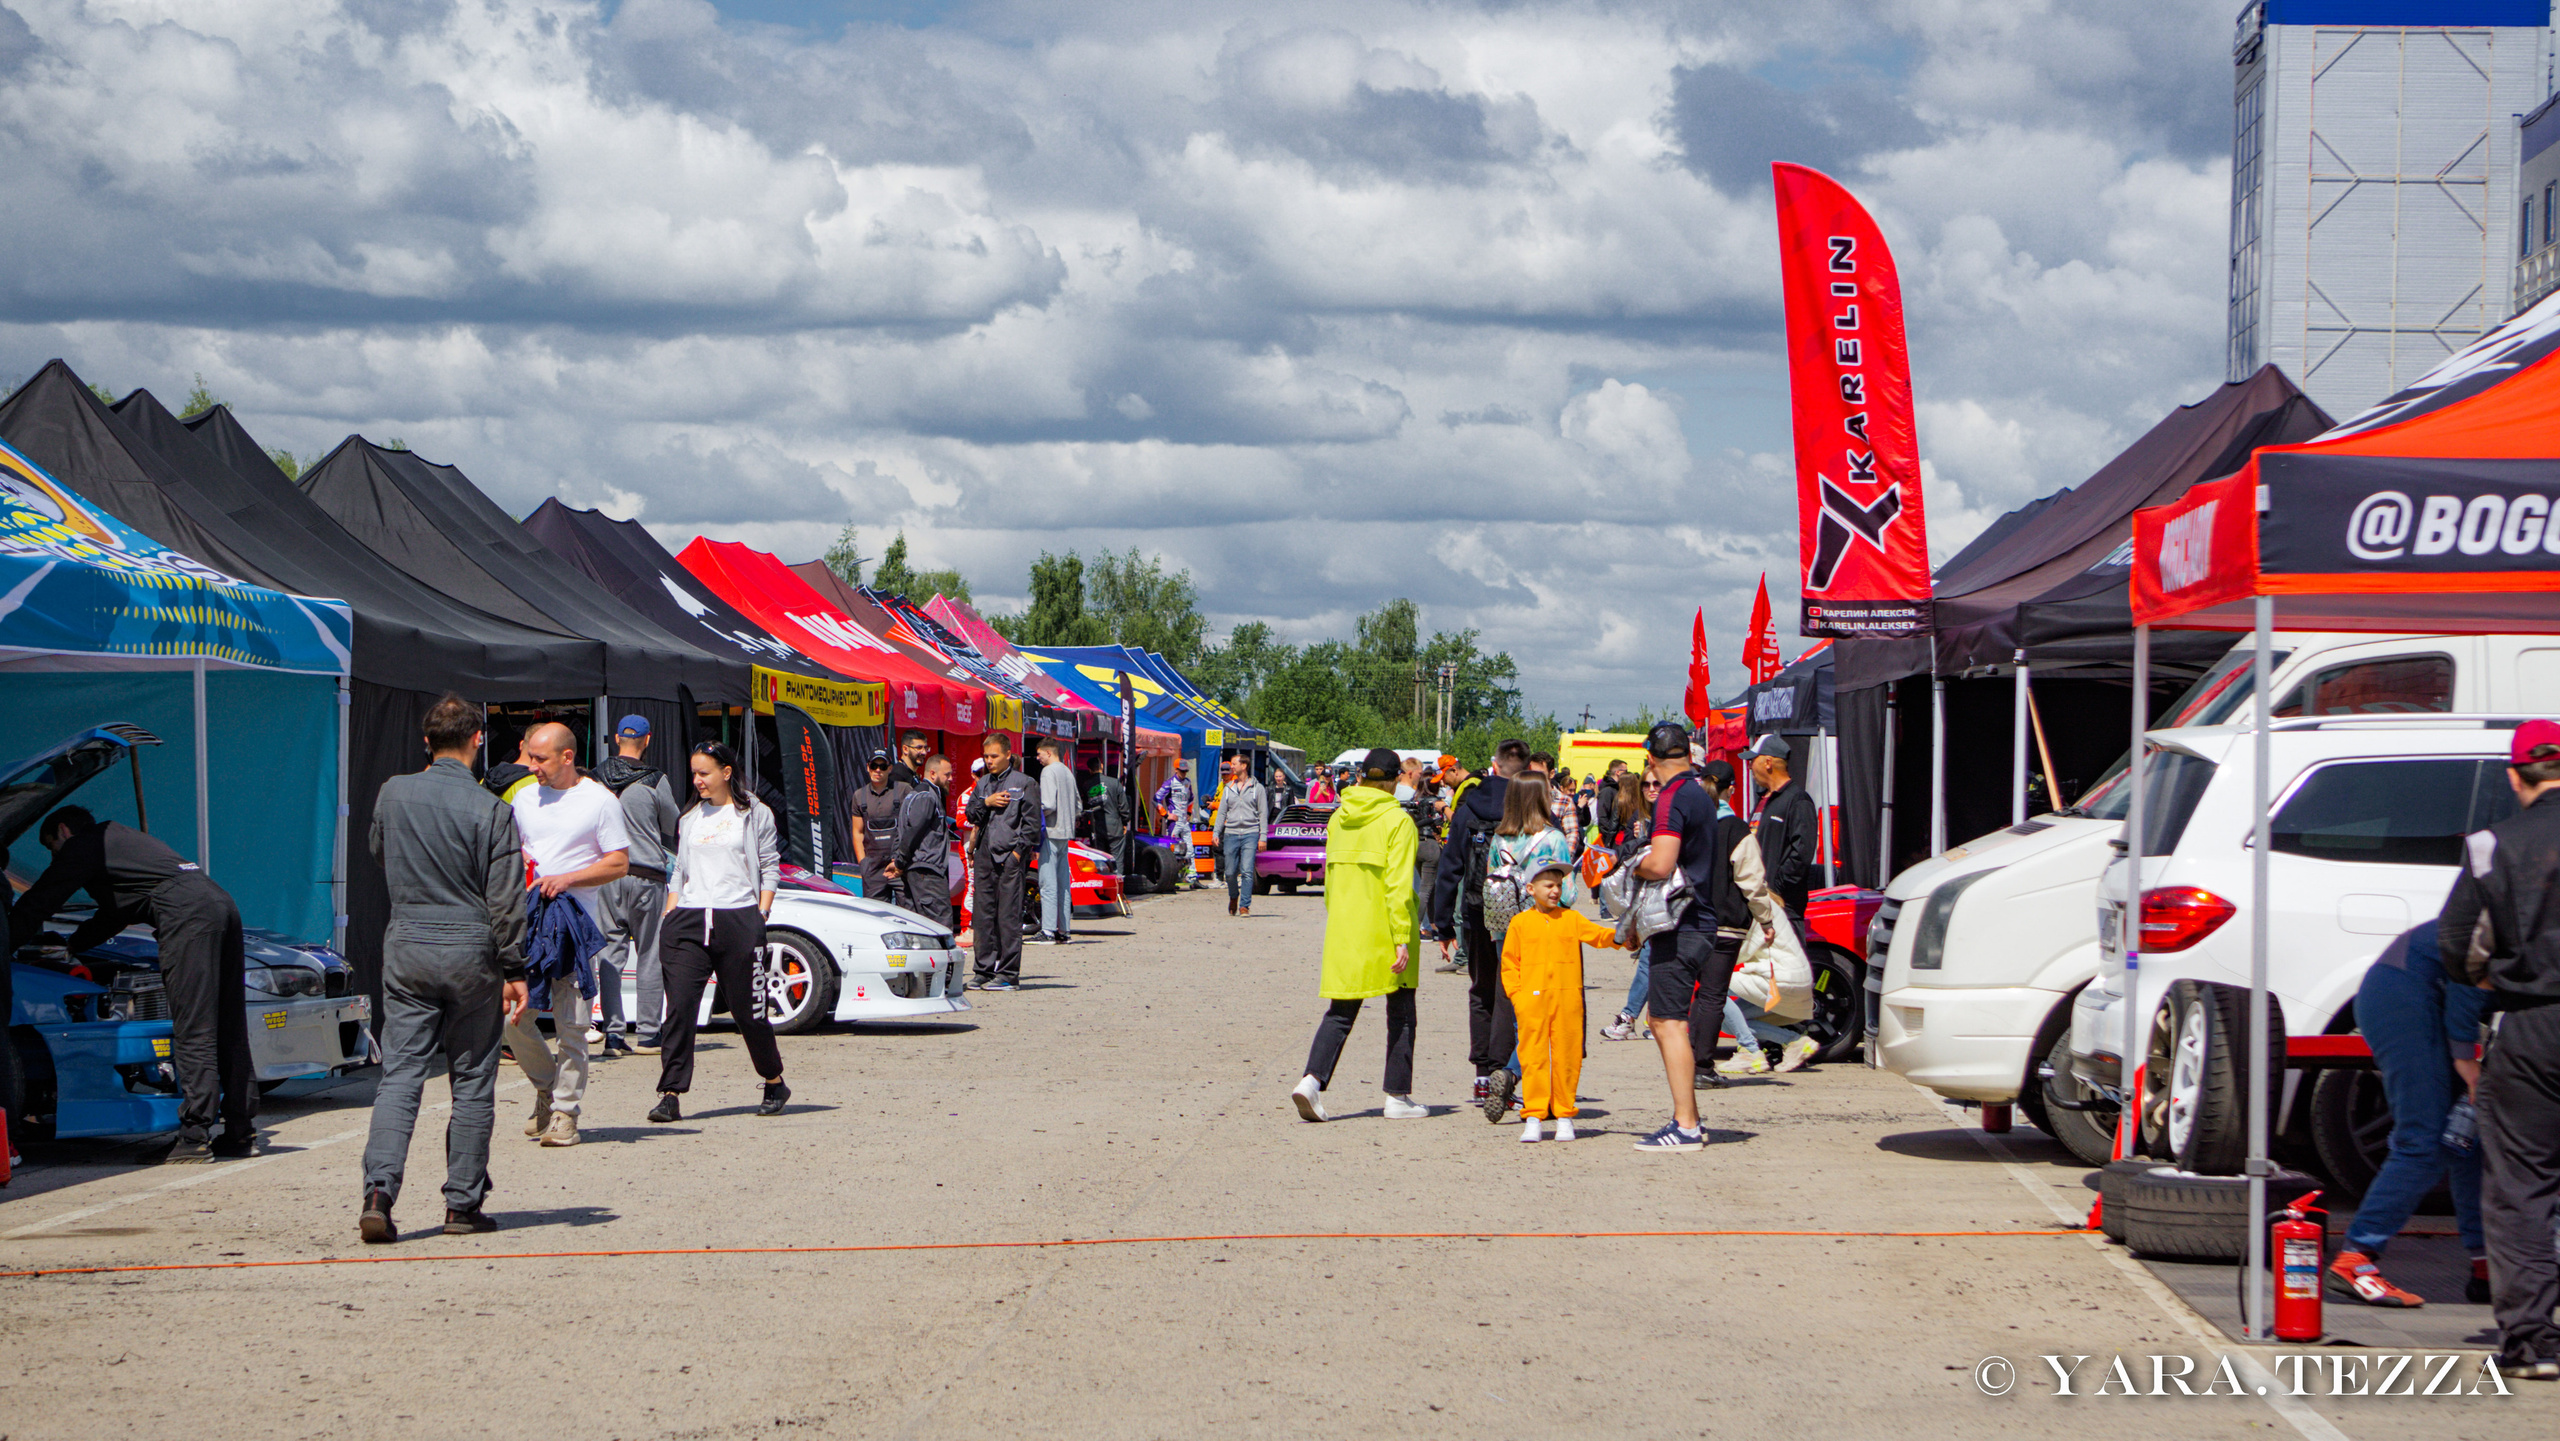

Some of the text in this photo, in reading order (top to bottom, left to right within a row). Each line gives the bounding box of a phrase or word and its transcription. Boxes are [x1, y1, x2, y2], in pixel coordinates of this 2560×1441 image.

[1828, 235, 1878, 484] KARELIN
[1820, 621, 1916, 630] KARELIN.ALEKSEY
[1822, 607, 1915, 618] КАРЕЛИН АЛЕКСЕЙ
[785, 680, 863, 706] PHANTOMEQUIPMENT.COM
[801, 744, 815, 815] POWER OF
[803, 726, 820, 816] TECHNOLOGY
[752, 946, 766, 1020] PROFIT
[265, 1016, 287, 1025] WEGO
